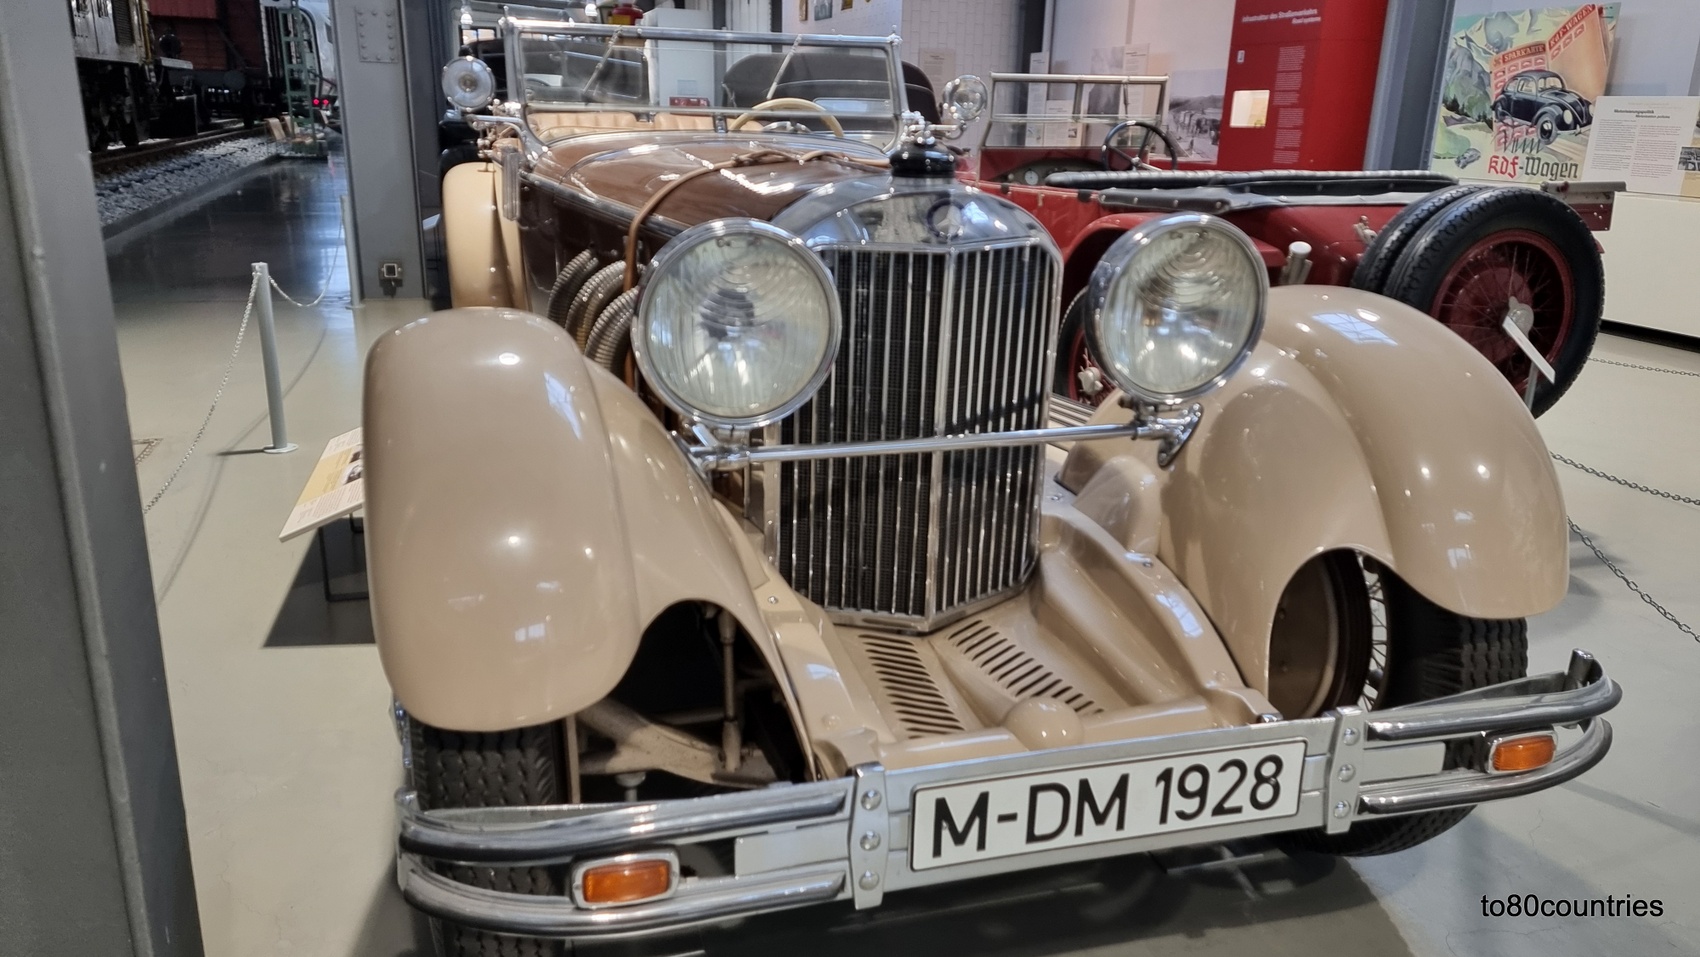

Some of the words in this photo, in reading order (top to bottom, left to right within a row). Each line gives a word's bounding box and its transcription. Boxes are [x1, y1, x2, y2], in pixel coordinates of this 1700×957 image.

[1504, 45, 1544, 60] SPARKARTE
[932, 773, 1130, 858] M-DM
[1155, 754, 1284, 826] 1928
